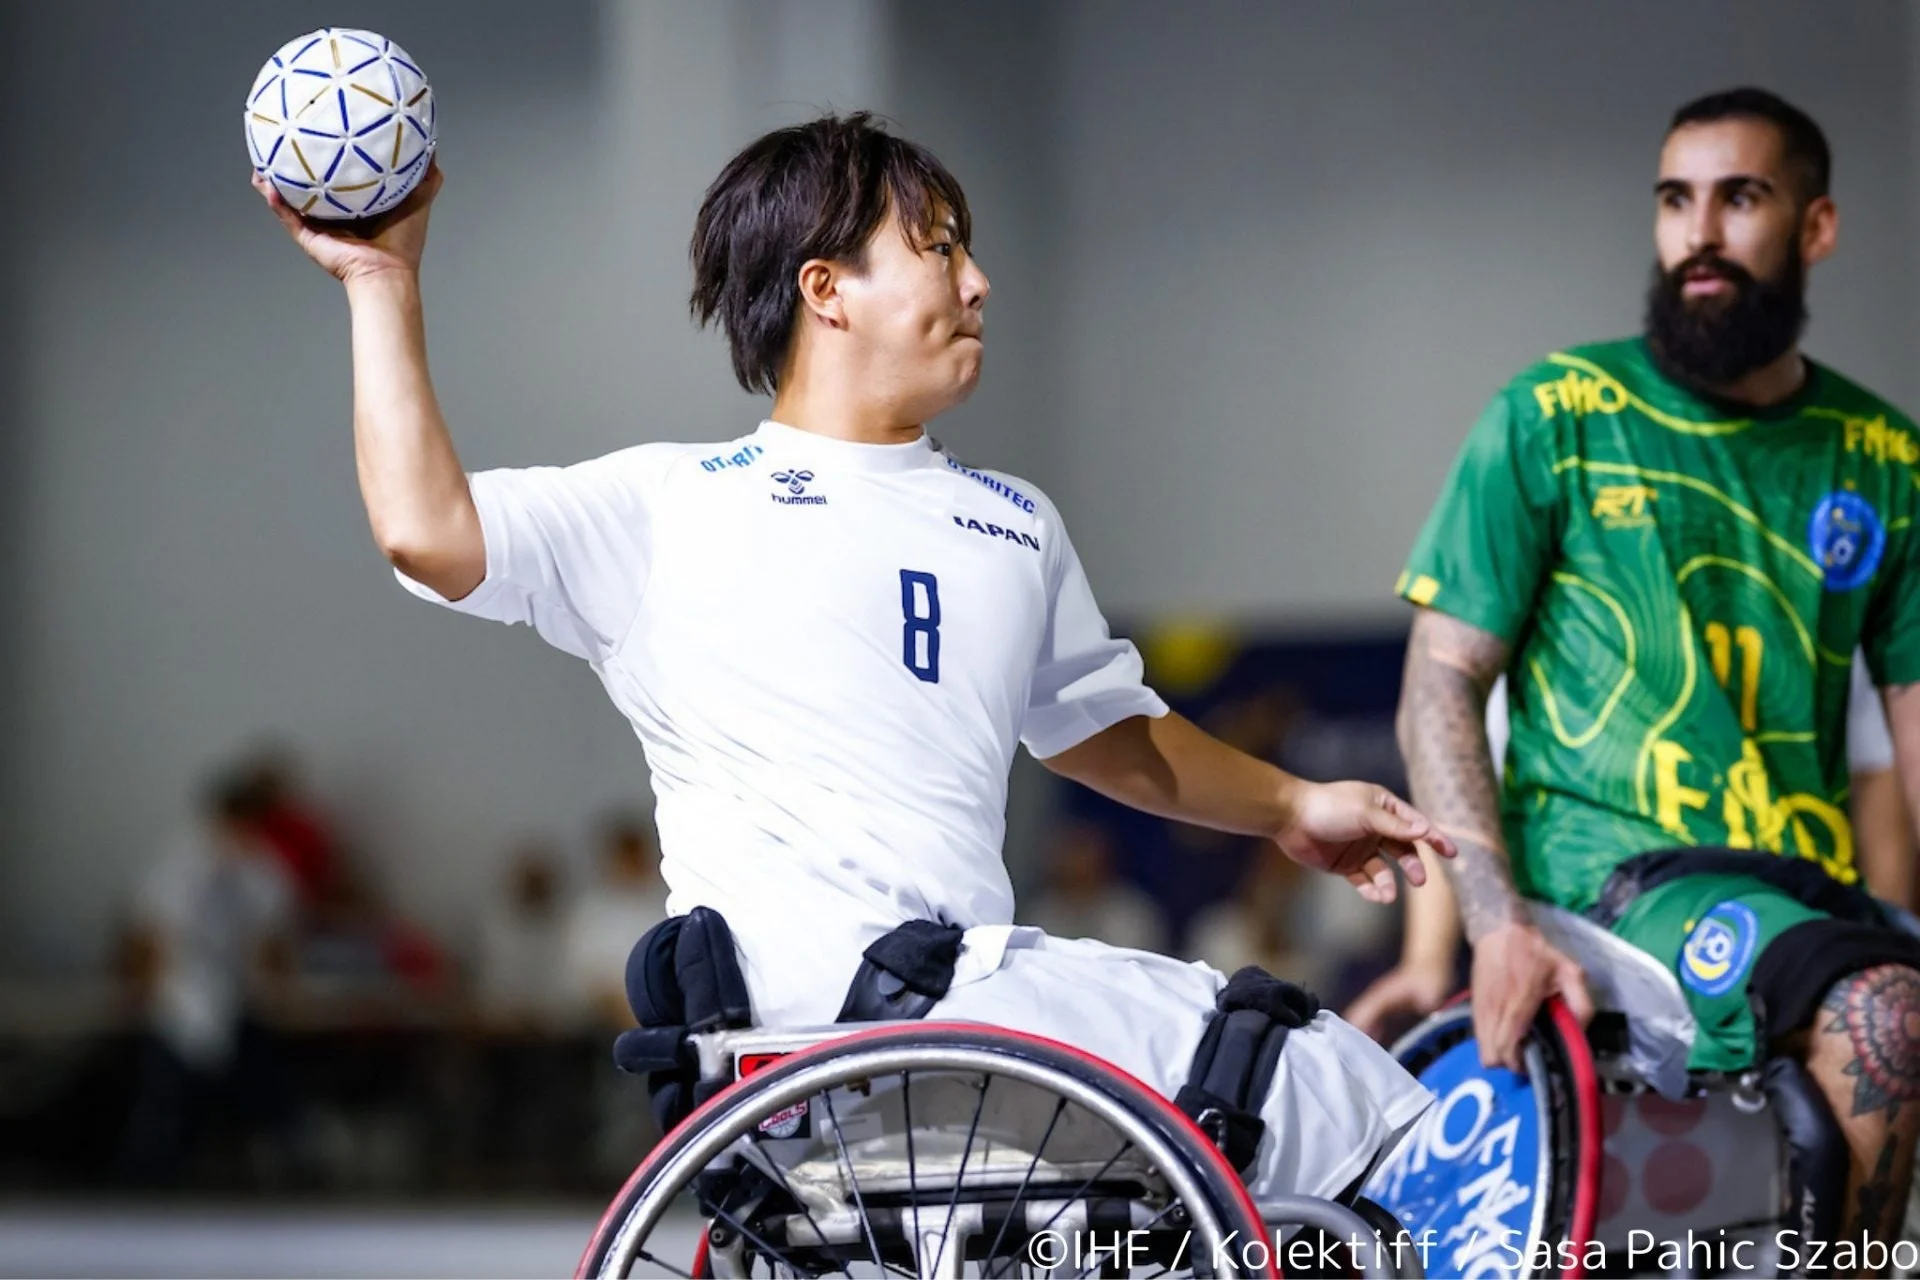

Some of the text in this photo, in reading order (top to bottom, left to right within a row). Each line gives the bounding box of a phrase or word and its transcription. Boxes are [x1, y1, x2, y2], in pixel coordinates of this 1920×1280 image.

[771, 493, 828, 505] hummel
[900, 569, 941, 683] 8
[1705, 621, 1763, 733] 11
